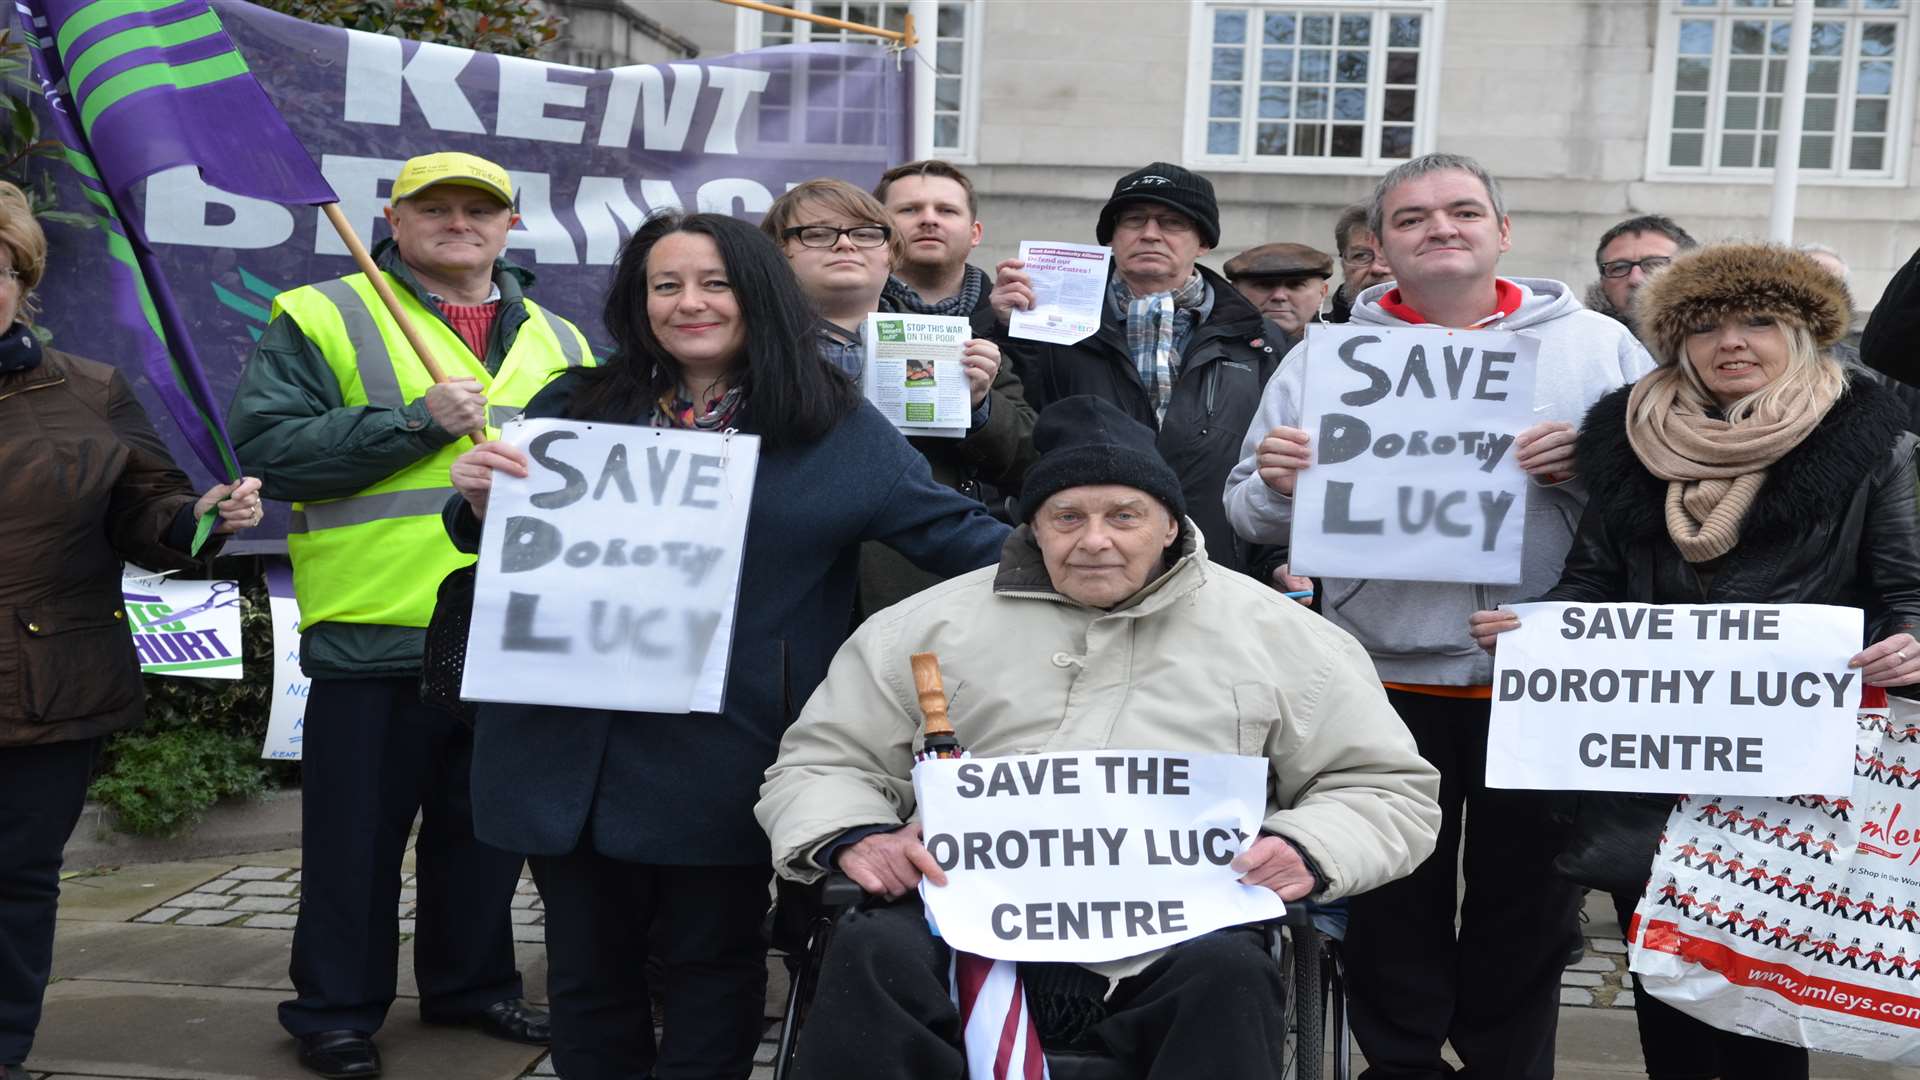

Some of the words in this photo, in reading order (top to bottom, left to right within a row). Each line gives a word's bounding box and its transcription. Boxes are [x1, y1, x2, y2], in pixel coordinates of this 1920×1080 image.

[343, 29, 770, 155] KENT
[906, 322, 926, 332] STOP
[927, 324, 945, 333] THIS
[945, 325, 963, 334] WAR
[906, 332, 918, 341] ON
[919, 333, 934, 342] THE
[935, 334, 955, 343] POOR
[1338, 335, 1516, 407] SAVE
[1318, 413, 1515, 473] DOROTHY
[529, 430, 723, 510] SAVE
[1322, 480, 1516, 552] LUCY
[501, 591, 722, 677] LUCY
[1560, 607, 1673, 640] SAVE
[1690, 609, 1780, 641] THE
[1499, 668, 1715, 704] DOROTHY
[1730, 671, 1855, 708] LUCY
[1578, 732, 1763, 773] CENTRE
[956, 757, 1080, 798] SAVE
[1095, 757, 1190, 796] THE
[927, 828, 1128, 872] OROTHY
[1858, 867, 1879, 878] Shop
[1901, 877, 1920, 886] Wor
[990, 900, 1188, 941] CENTRE
